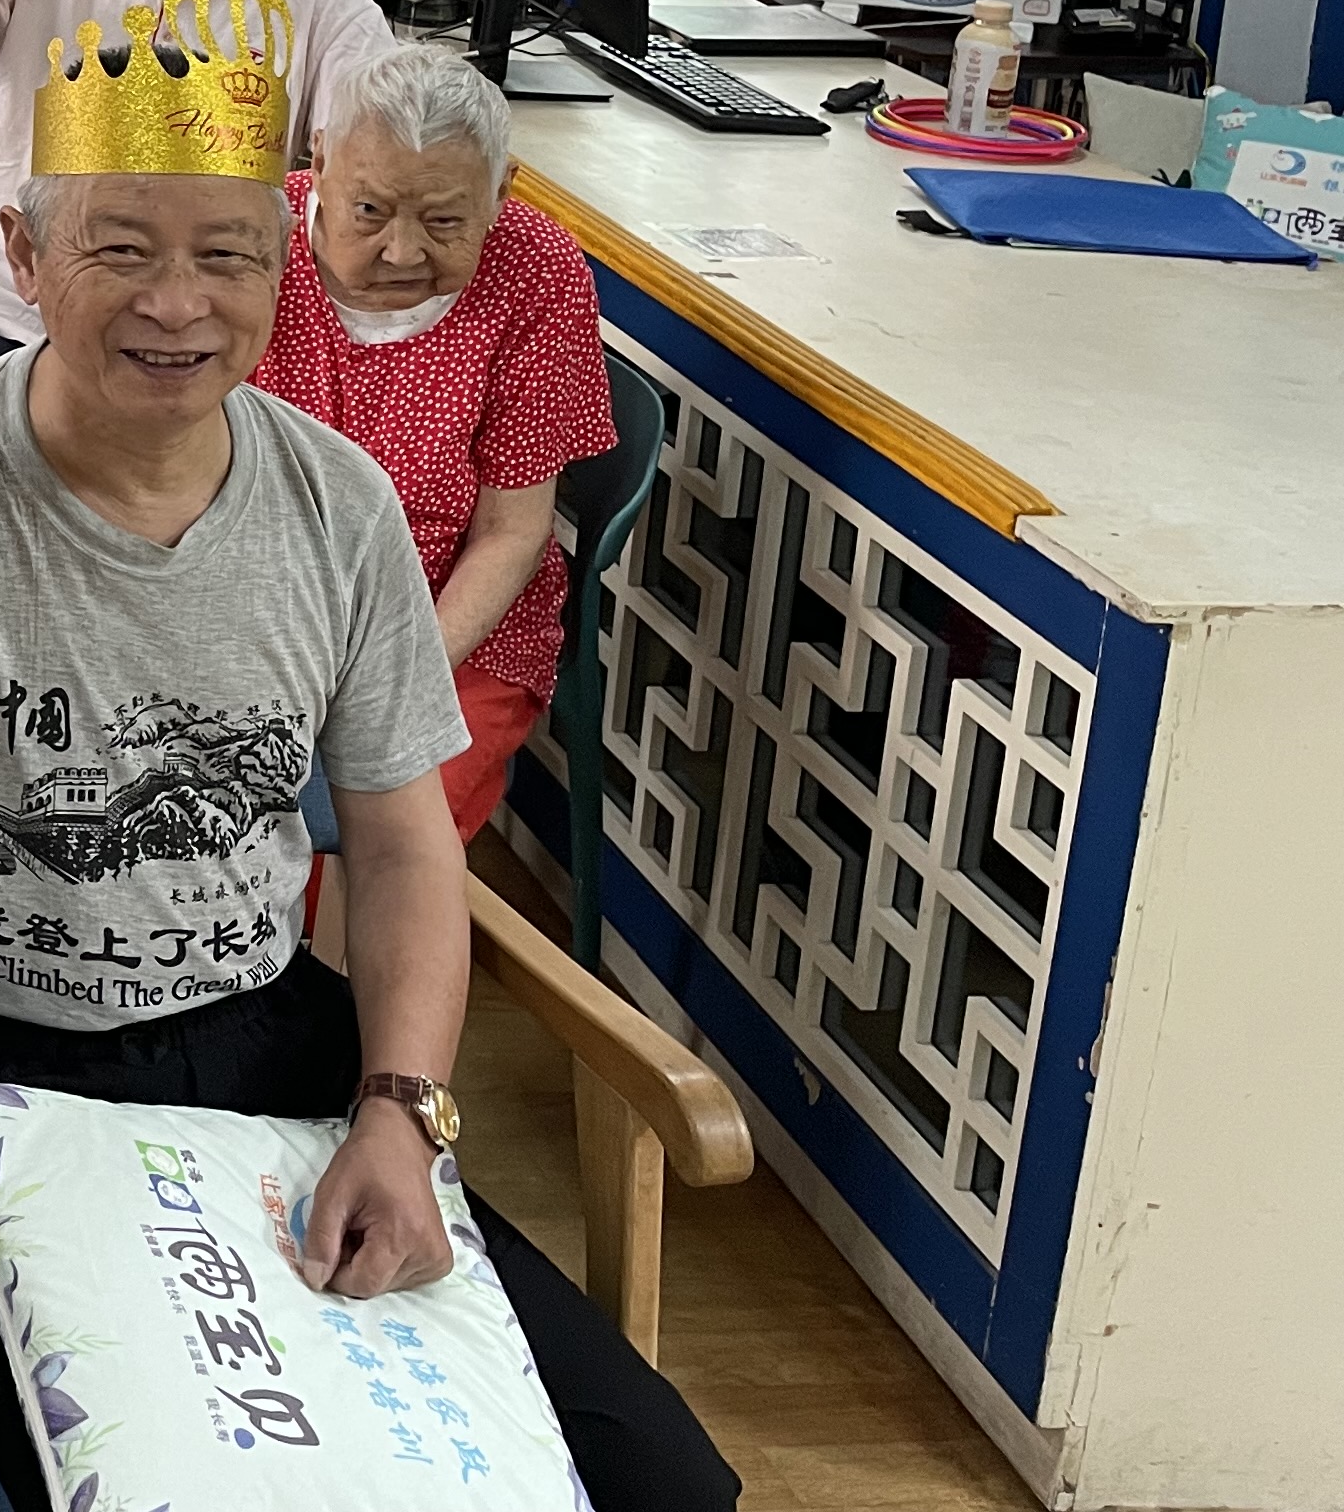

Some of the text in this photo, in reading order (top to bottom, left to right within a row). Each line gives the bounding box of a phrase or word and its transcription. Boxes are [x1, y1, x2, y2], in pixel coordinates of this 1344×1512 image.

[165, 108, 243, 153] Happy
[112, 979, 164, 1009] The
[170, 972, 243, 1003] Great
[152, 1218, 321, 1448] 俩宝贝
[318, 1306, 434, 1467] 银海培训
[379, 1316, 491, 1485] 银海家政
